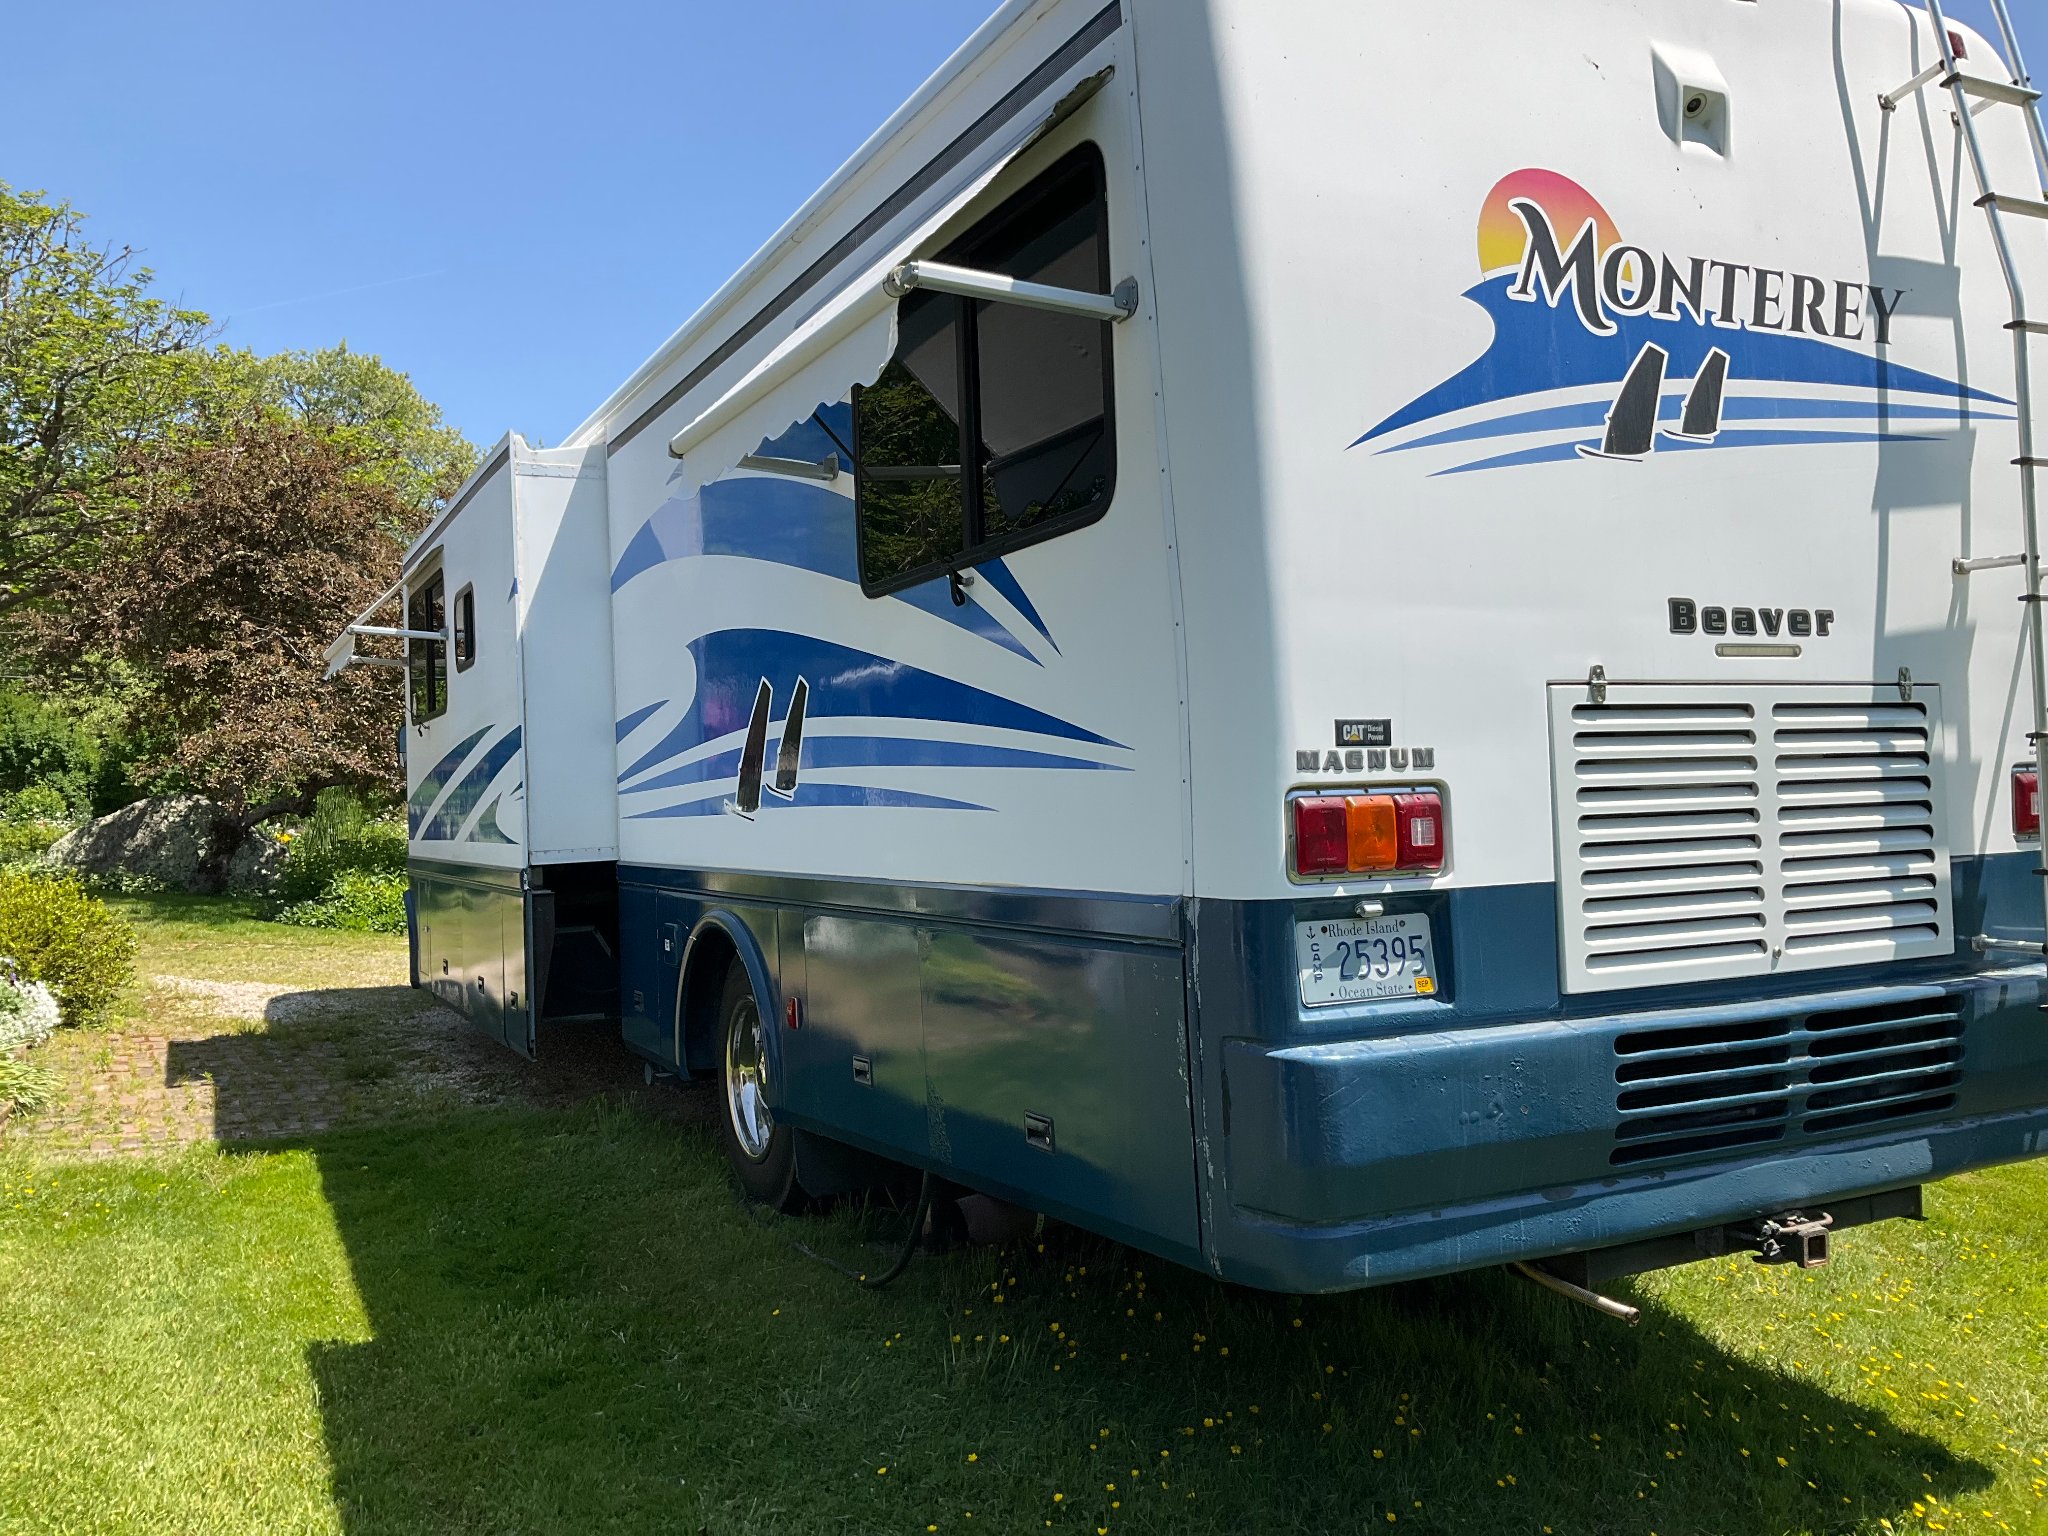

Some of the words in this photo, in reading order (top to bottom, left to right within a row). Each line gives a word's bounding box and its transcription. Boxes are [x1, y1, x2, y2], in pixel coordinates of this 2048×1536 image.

[1508, 198, 1906, 345] MONTEREY
[1667, 597, 1834, 637] Beaver
[1342, 724, 1365, 741] CAT
[1367, 724, 1384, 732] Diesel
[1367, 733, 1385, 741] Power
[1296, 747, 1435, 773] MAGNUM
[1328, 922, 1362, 938] Rhode
[1366, 919, 1399, 935] Island
[1310, 942, 1324, 984] CAMP
[1336, 934, 1426, 982] 25395
[1338, 985, 1373, 1000] Ocean
[1376, 982, 1404, 996] State
